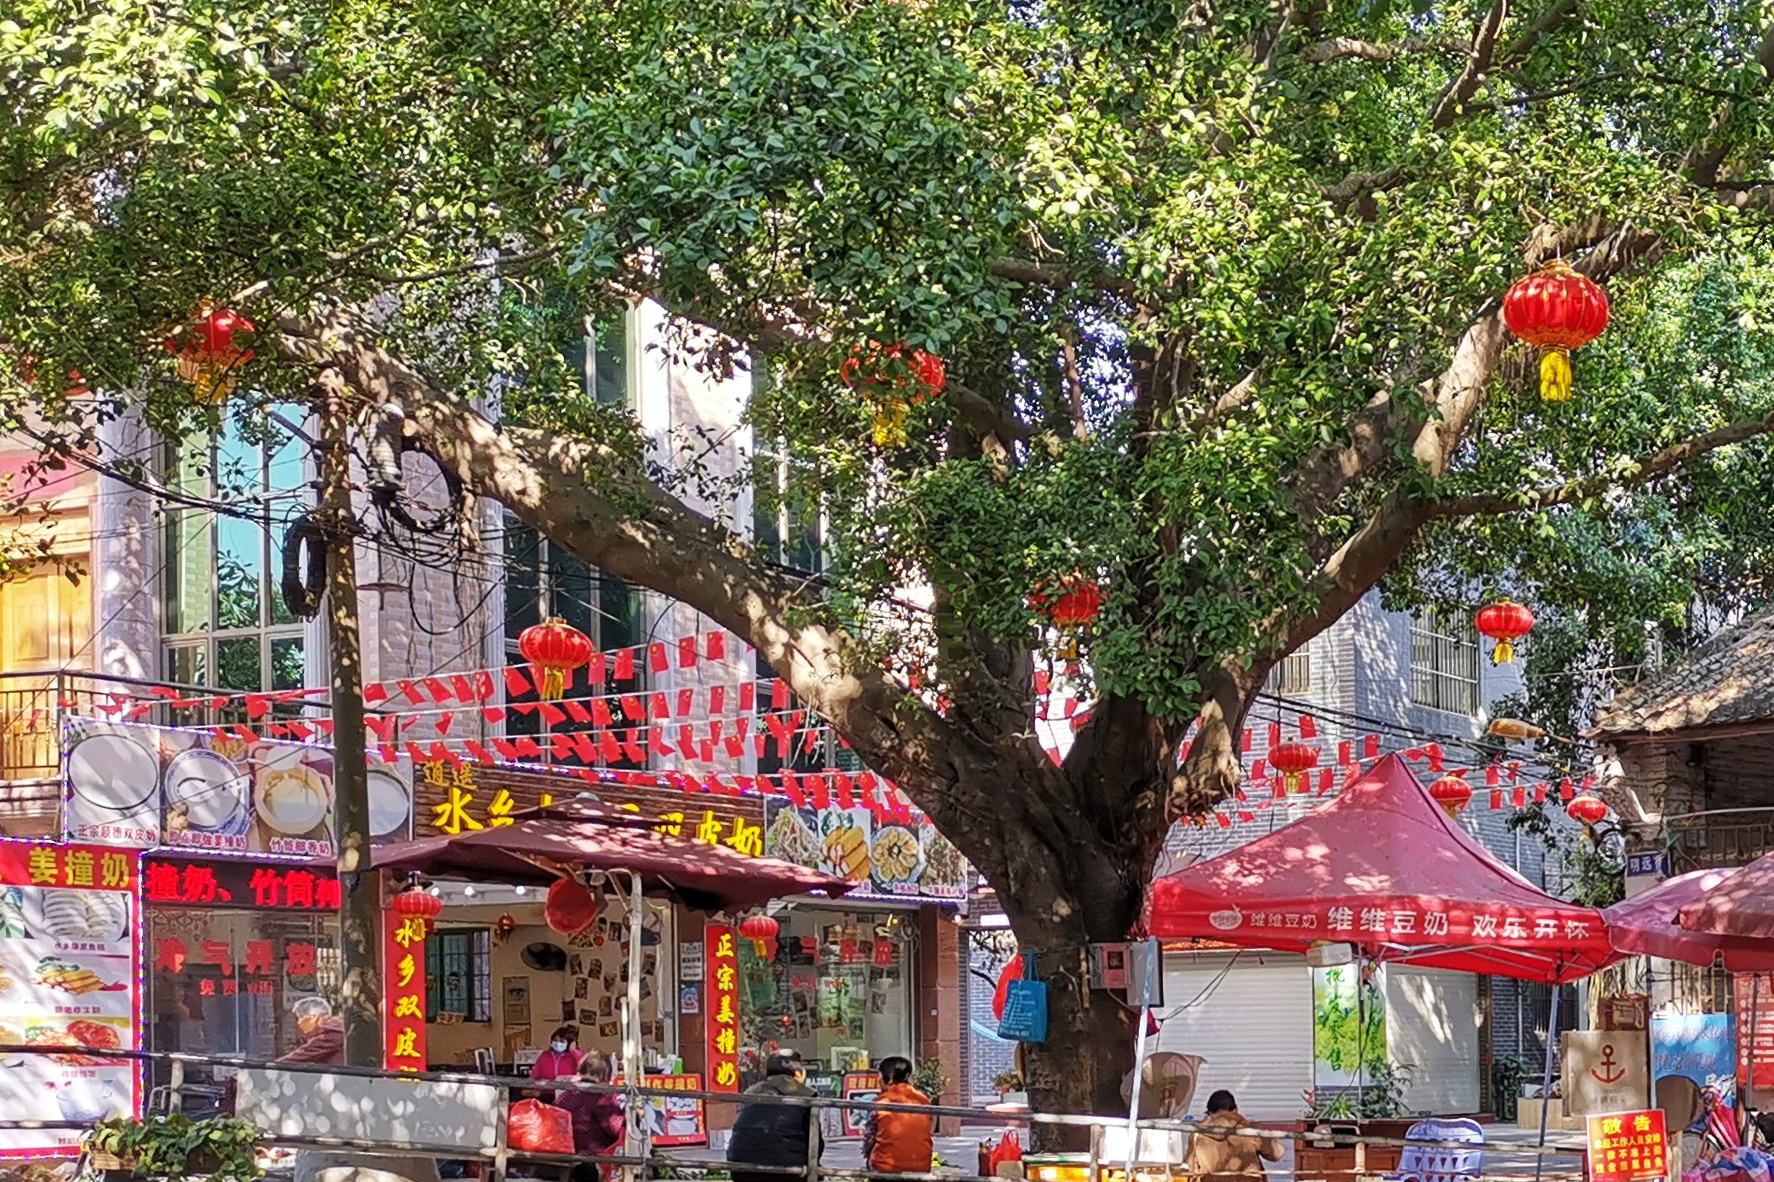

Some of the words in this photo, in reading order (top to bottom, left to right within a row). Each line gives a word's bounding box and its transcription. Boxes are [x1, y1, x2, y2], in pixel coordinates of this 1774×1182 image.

[28, 847, 129, 887] 姜撞奶
[1250, 913, 1317, 929] 维维豆奶
[1327, 906, 1449, 935] 维维豆奶
[1471, 914, 1590, 939] 欢乐开怀
[714, 932, 738, 1087] 正宗姜撞奶
